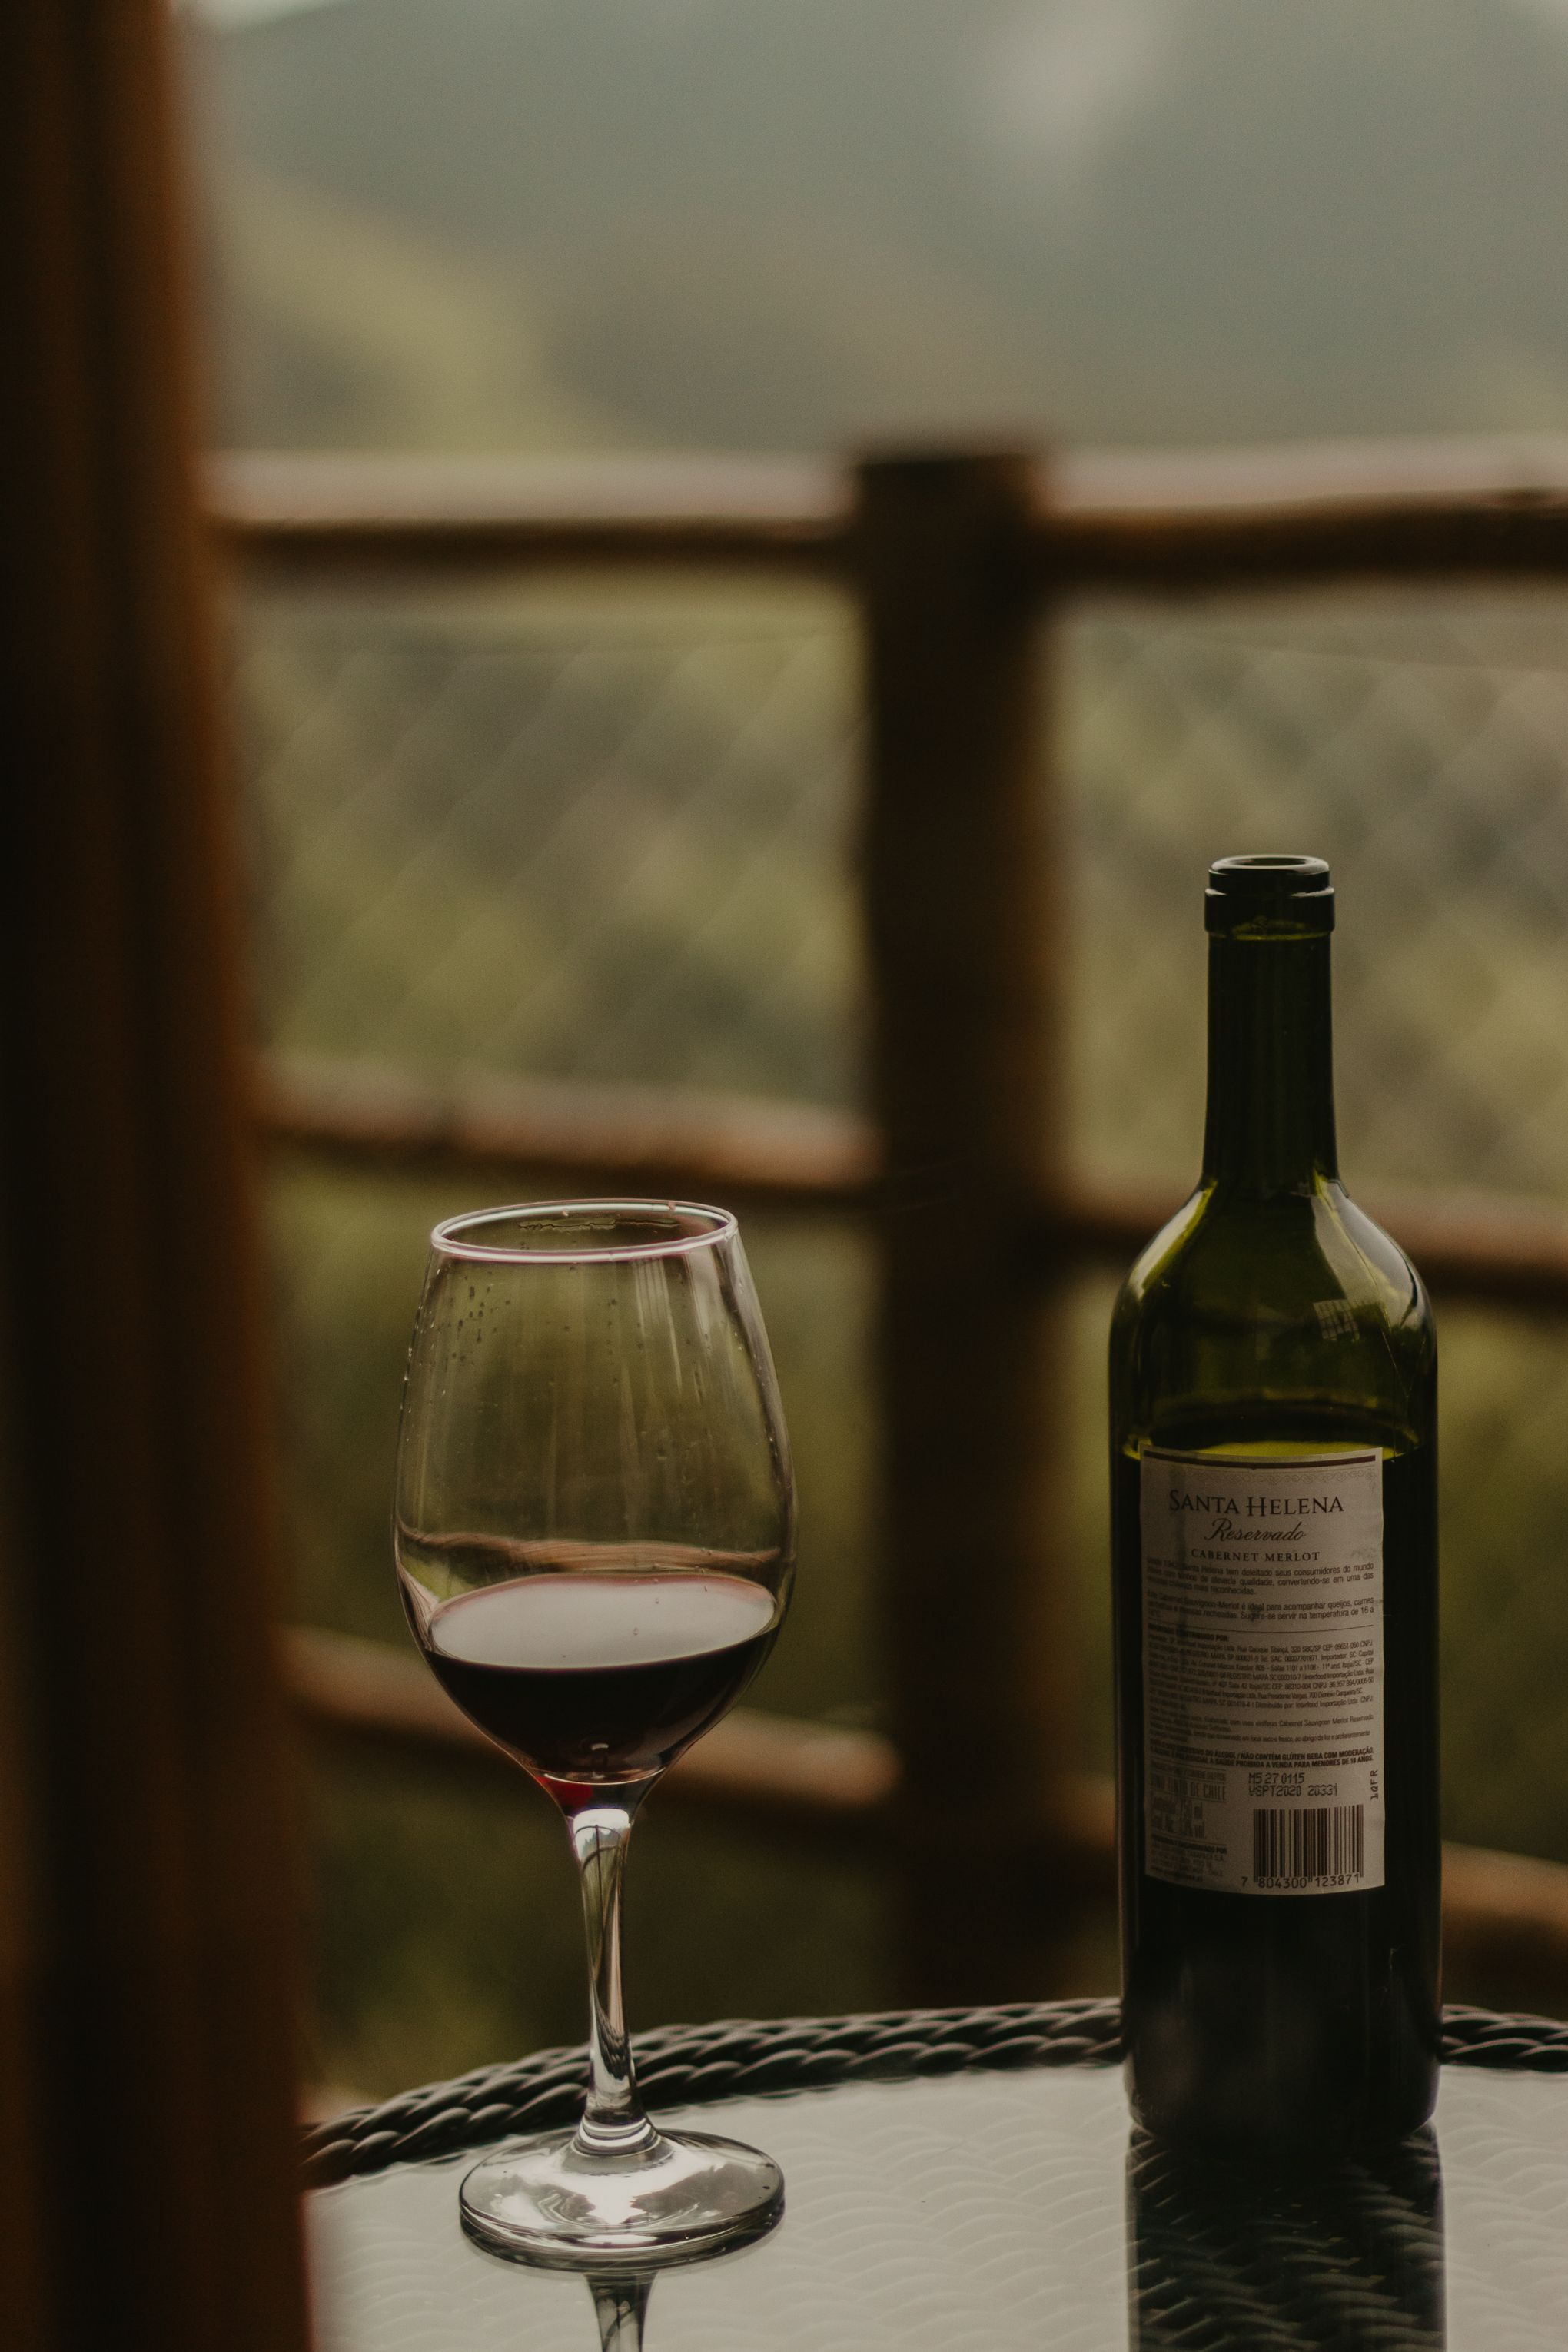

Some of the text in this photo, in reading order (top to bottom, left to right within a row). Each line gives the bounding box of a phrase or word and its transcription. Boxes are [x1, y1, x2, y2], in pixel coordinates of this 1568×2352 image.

[1169, 1490, 1345, 1517] SANTA HELENA
[1204, 1518, 1307, 1541] Reservado
[1191, 1548, 1321, 1562] CABERNET MERLOT
[1241, 1568, 1273, 1576] deleitado
[1294, 1566, 1340, 1576] consumidores
[1353, 1562, 1374, 1572] mundo
[1239, 1577, 1274, 1586] qualidade,
[1277, 1576, 1330, 1586] convertendo-se
[1347, 1573, 1360, 1582] uma
[1363, 1571, 1374, 1580] das
[1267, 1603, 1283, 1613] para
[1284, 1602, 1326, 1613] acompanhar
[1354, 1597, 1374, 1606] carnes
[1278, 1611, 1297, 1620] servir
[1299, 1612, 1307, 1620] na
[1310, 1609, 1350, 1620] temperatura
[1351, 1607, 1359, 1616] de
[1361, 1606, 1369, 1614] 16
[1241, 1751, 1254, 1760] NÃO
[1307, 1752, 1323, 1760] BEBA
[1324, 1750, 1338, 1759] COM
[1271, 1759, 1293, 1769] VENDA
[1294, 1759, 1311, 1768] PARA
[1311, 1757, 1340, 1767] MENORES
[1342, 1756, 1350, 1766] DE
[1357, 1753, 1374, 1763] ANOS.
[1202, 1782, 1227, 1801] CHILE
[1307, 1783, 1337, 1797] 20331
[1241, 1873, 1359, 1889] 7 804300 123871
